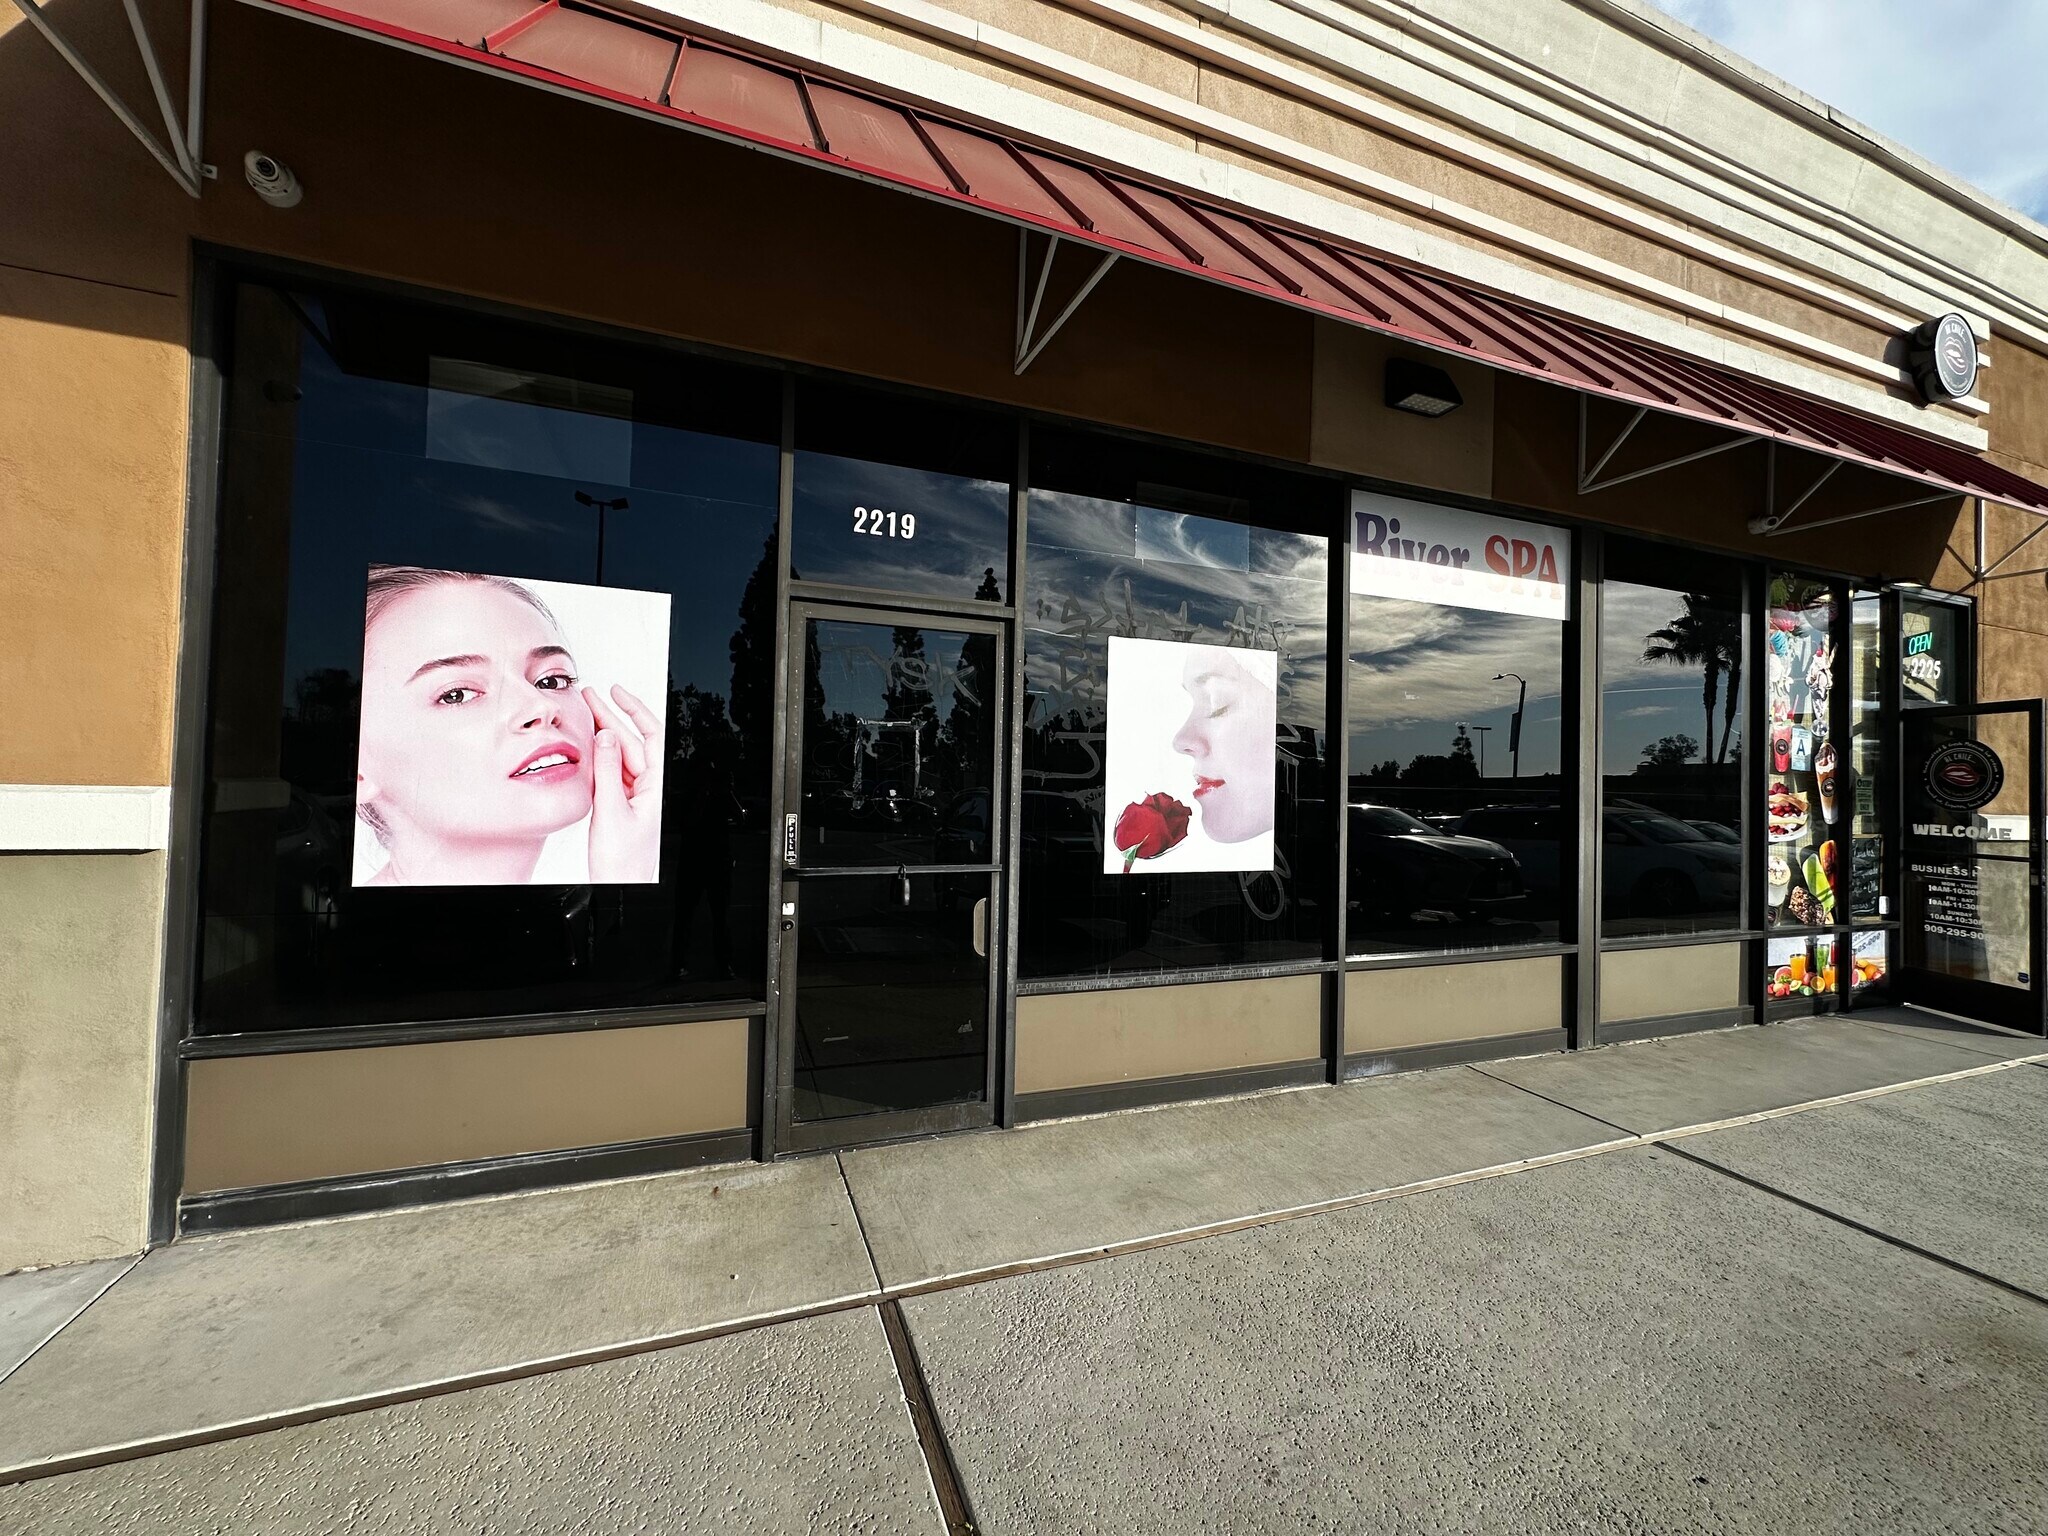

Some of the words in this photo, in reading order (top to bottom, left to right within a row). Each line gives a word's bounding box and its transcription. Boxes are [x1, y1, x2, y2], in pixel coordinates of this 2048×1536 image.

[853, 507, 916, 540] 2219
[1354, 511, 1470, 584] River
[1484, 534, 1562, 600] SPA
[1909, 632, 1932, 655] OPEN
[1911, 658, 1941, 680] 2225
[1796, 739, 1806, 756] A
[1912, 824, 2011, 839] WELCOME
[1911, 864, 1968, 876] BUSINESS
